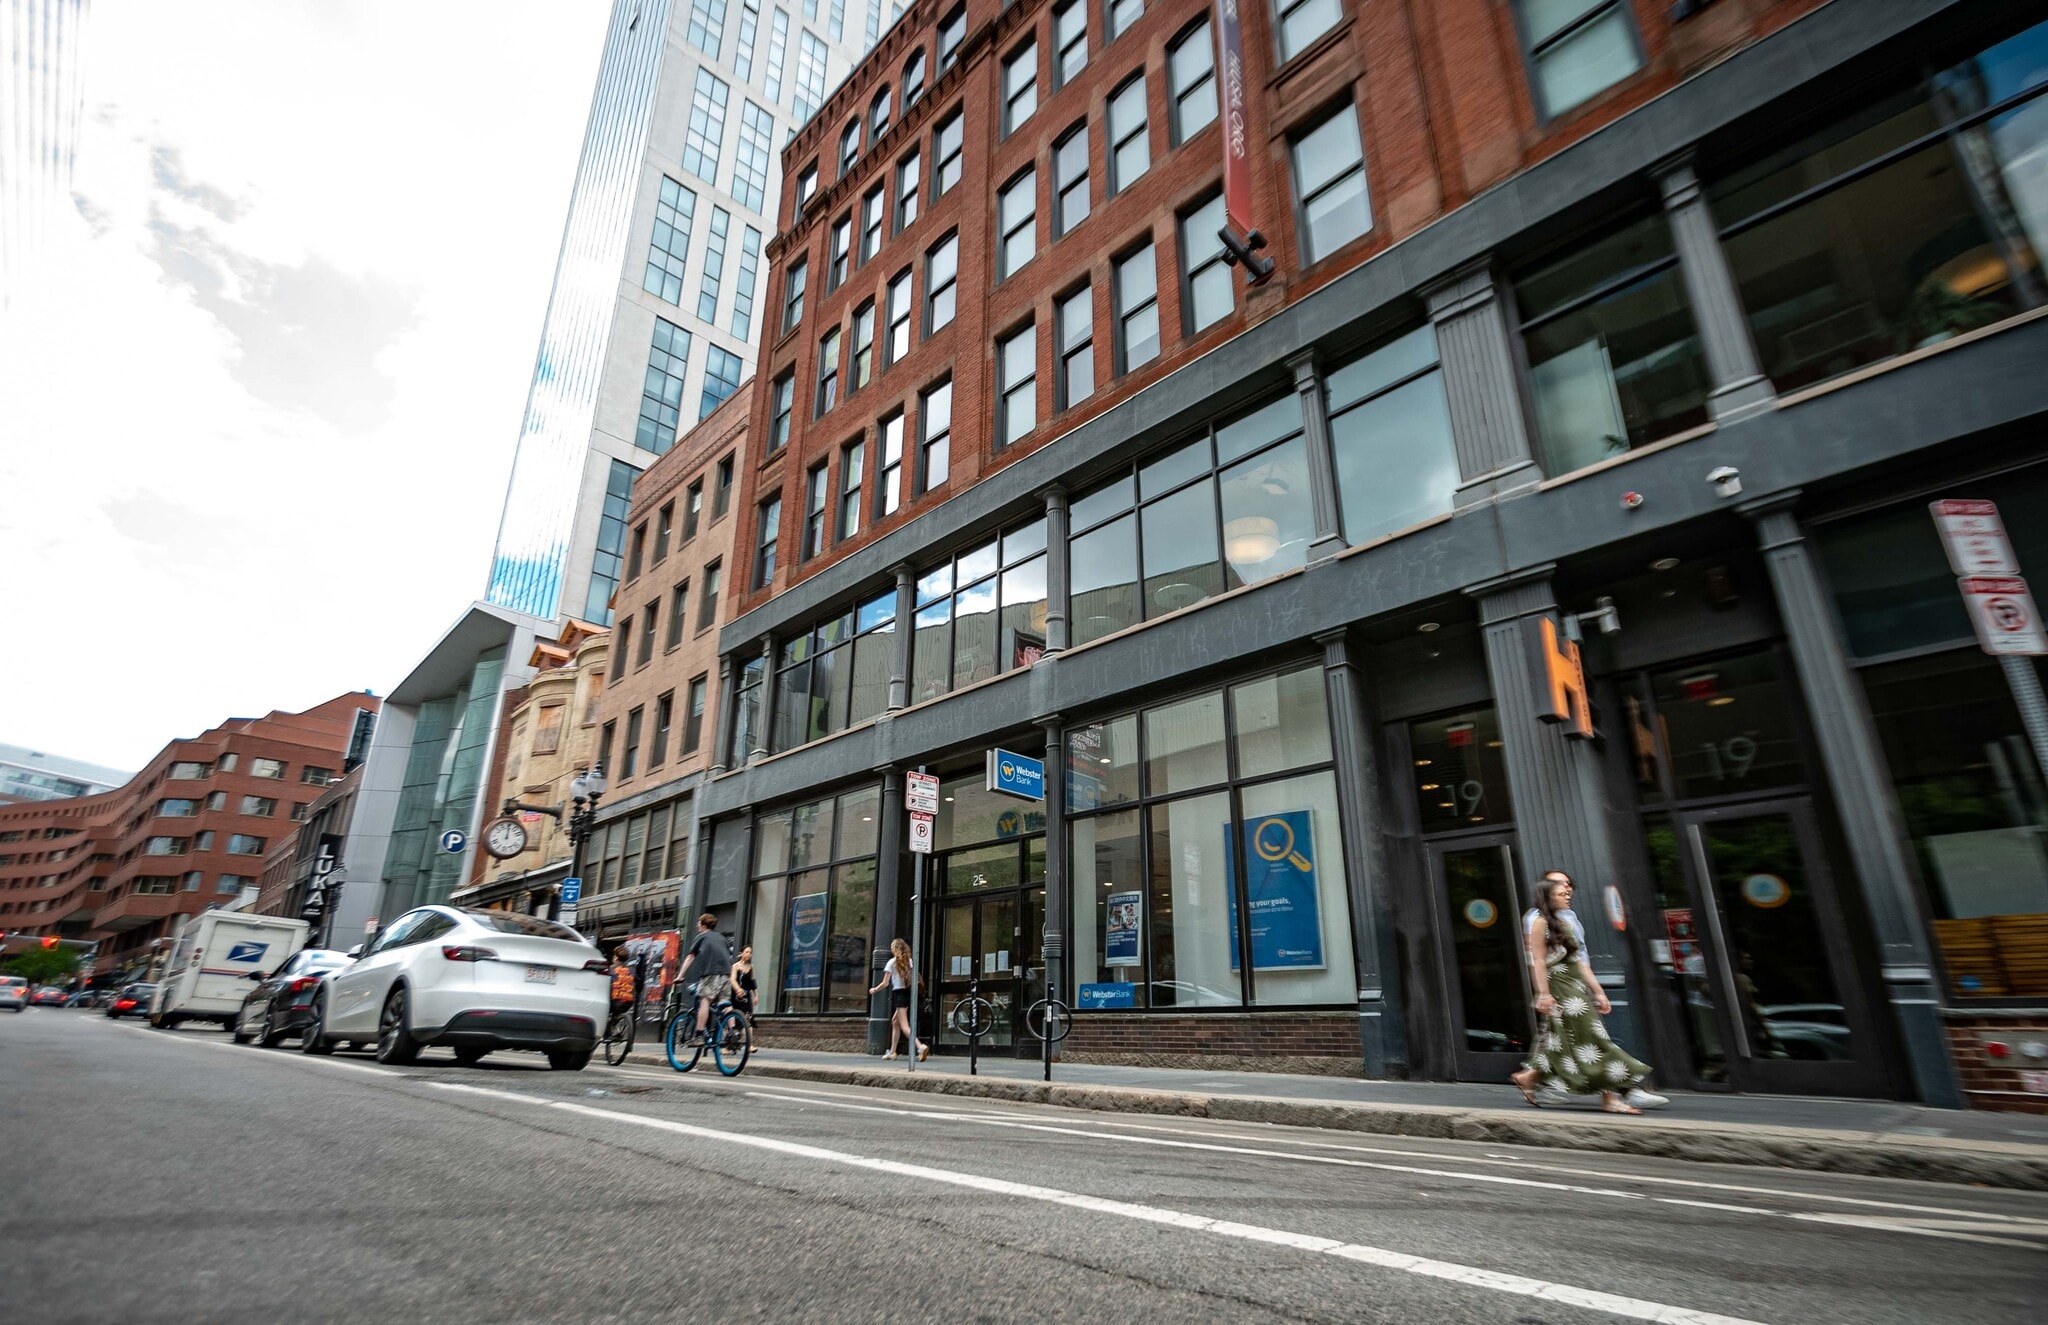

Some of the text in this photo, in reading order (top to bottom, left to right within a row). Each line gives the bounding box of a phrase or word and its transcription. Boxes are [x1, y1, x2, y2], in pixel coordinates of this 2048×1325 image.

[1701, 736, 1757, 780] 19
[1016, 765, 1041, 780] Webster
[1016, 774, 1032, 786] Bank
[1445, 780, 1484, 816] 19
[304, 844, 335, 906] LUKA
[973, 874, 984, 886] 25
[1255, 900, 1270, 908] your
